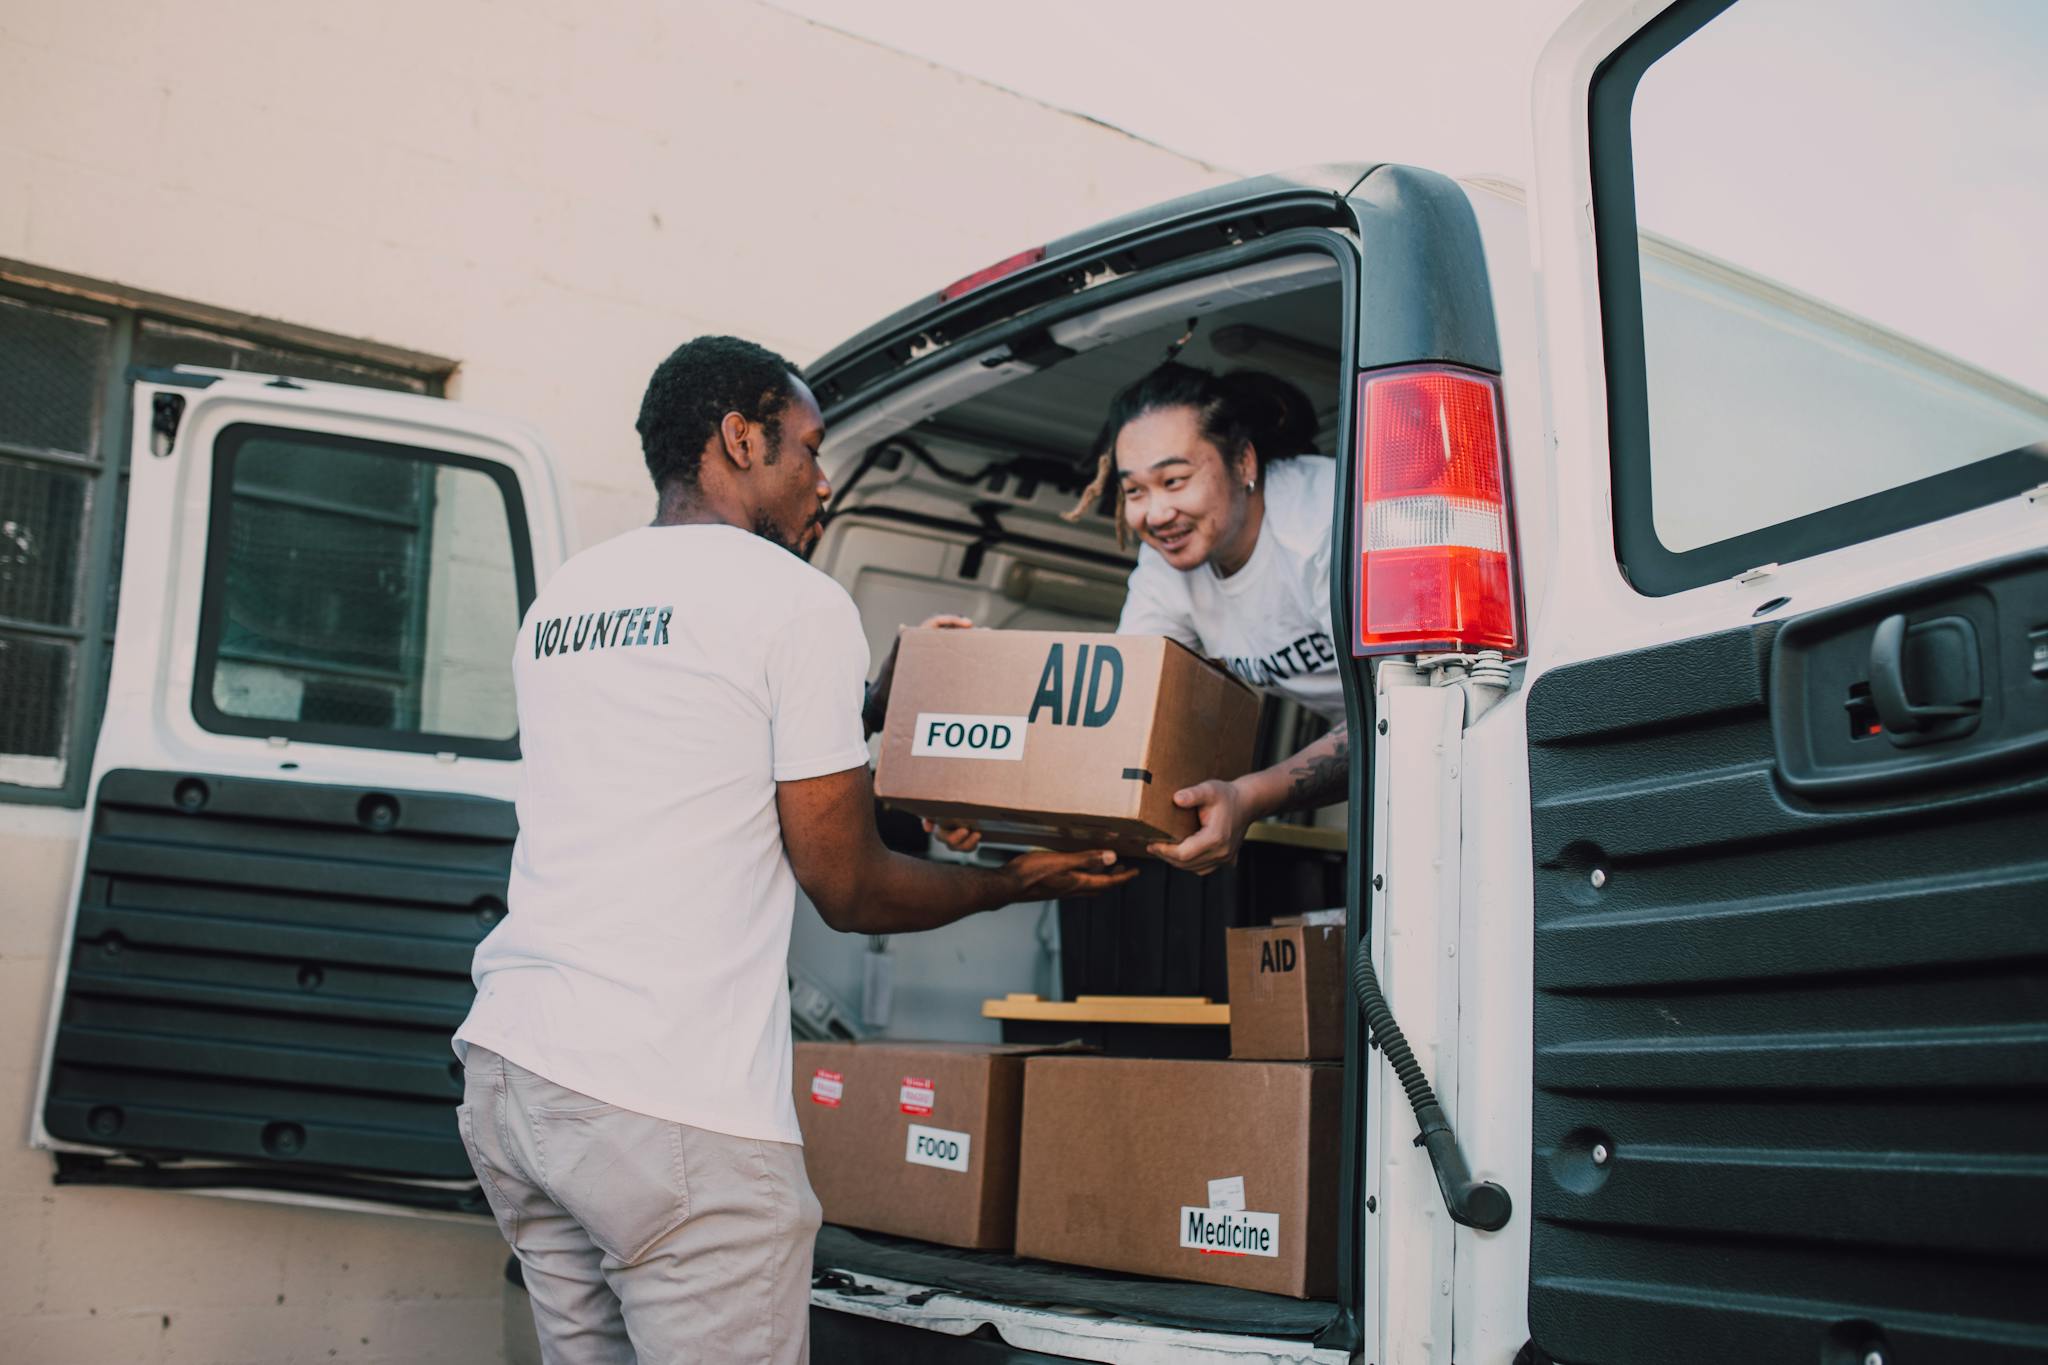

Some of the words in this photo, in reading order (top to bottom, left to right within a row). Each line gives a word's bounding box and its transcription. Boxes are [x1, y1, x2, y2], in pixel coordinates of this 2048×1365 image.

[534, 606, 673, 660] VOLUNTEER
[1028, 643, 1124, 728] AID
[927, 721, 1012, 750] FOOD
[1260, 938, 1297, 974] AID
[916, 1135, 959, 1161] FOOD
[1188, 1211, 1270, 1251] Medicine
